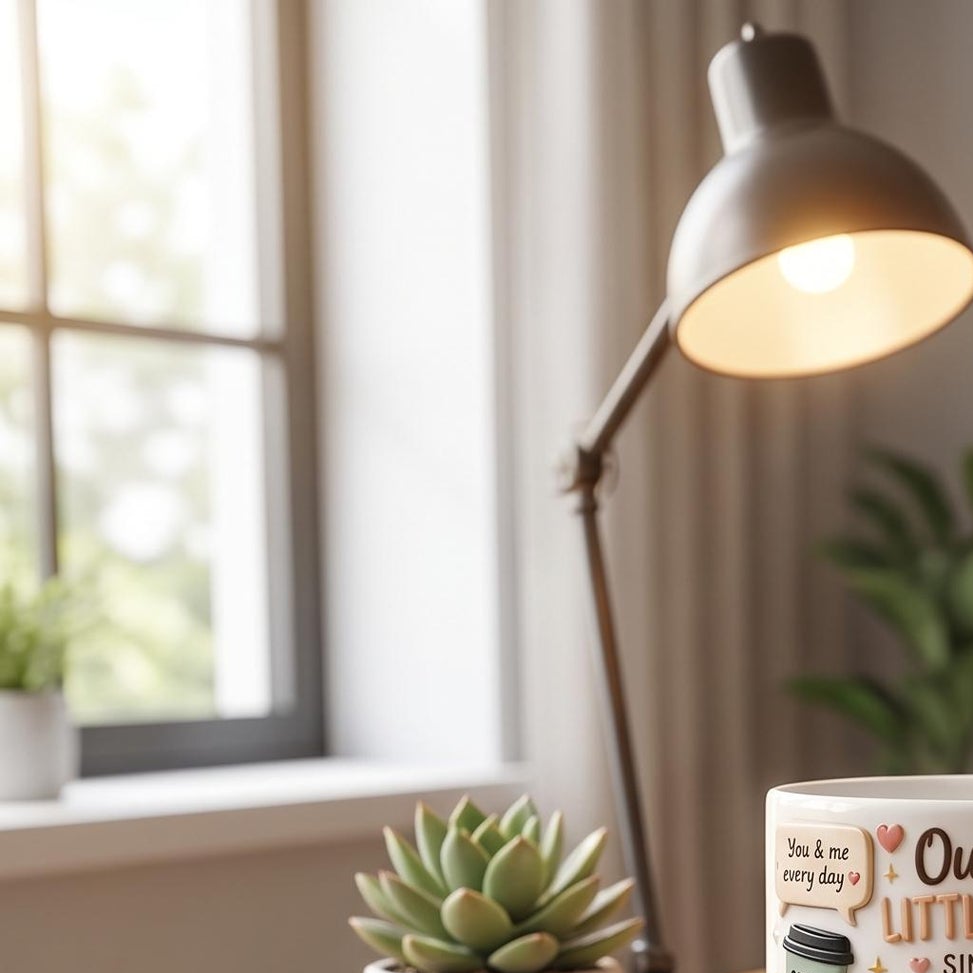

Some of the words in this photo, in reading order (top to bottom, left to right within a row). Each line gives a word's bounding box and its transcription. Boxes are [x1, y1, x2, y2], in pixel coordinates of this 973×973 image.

[787, 838, 810, 858] You
[814, 839, 824, 859] &
[828, 846, 849, 860] me
[783, 869, 814, 892] every
[818, 865, 844, 893] day
